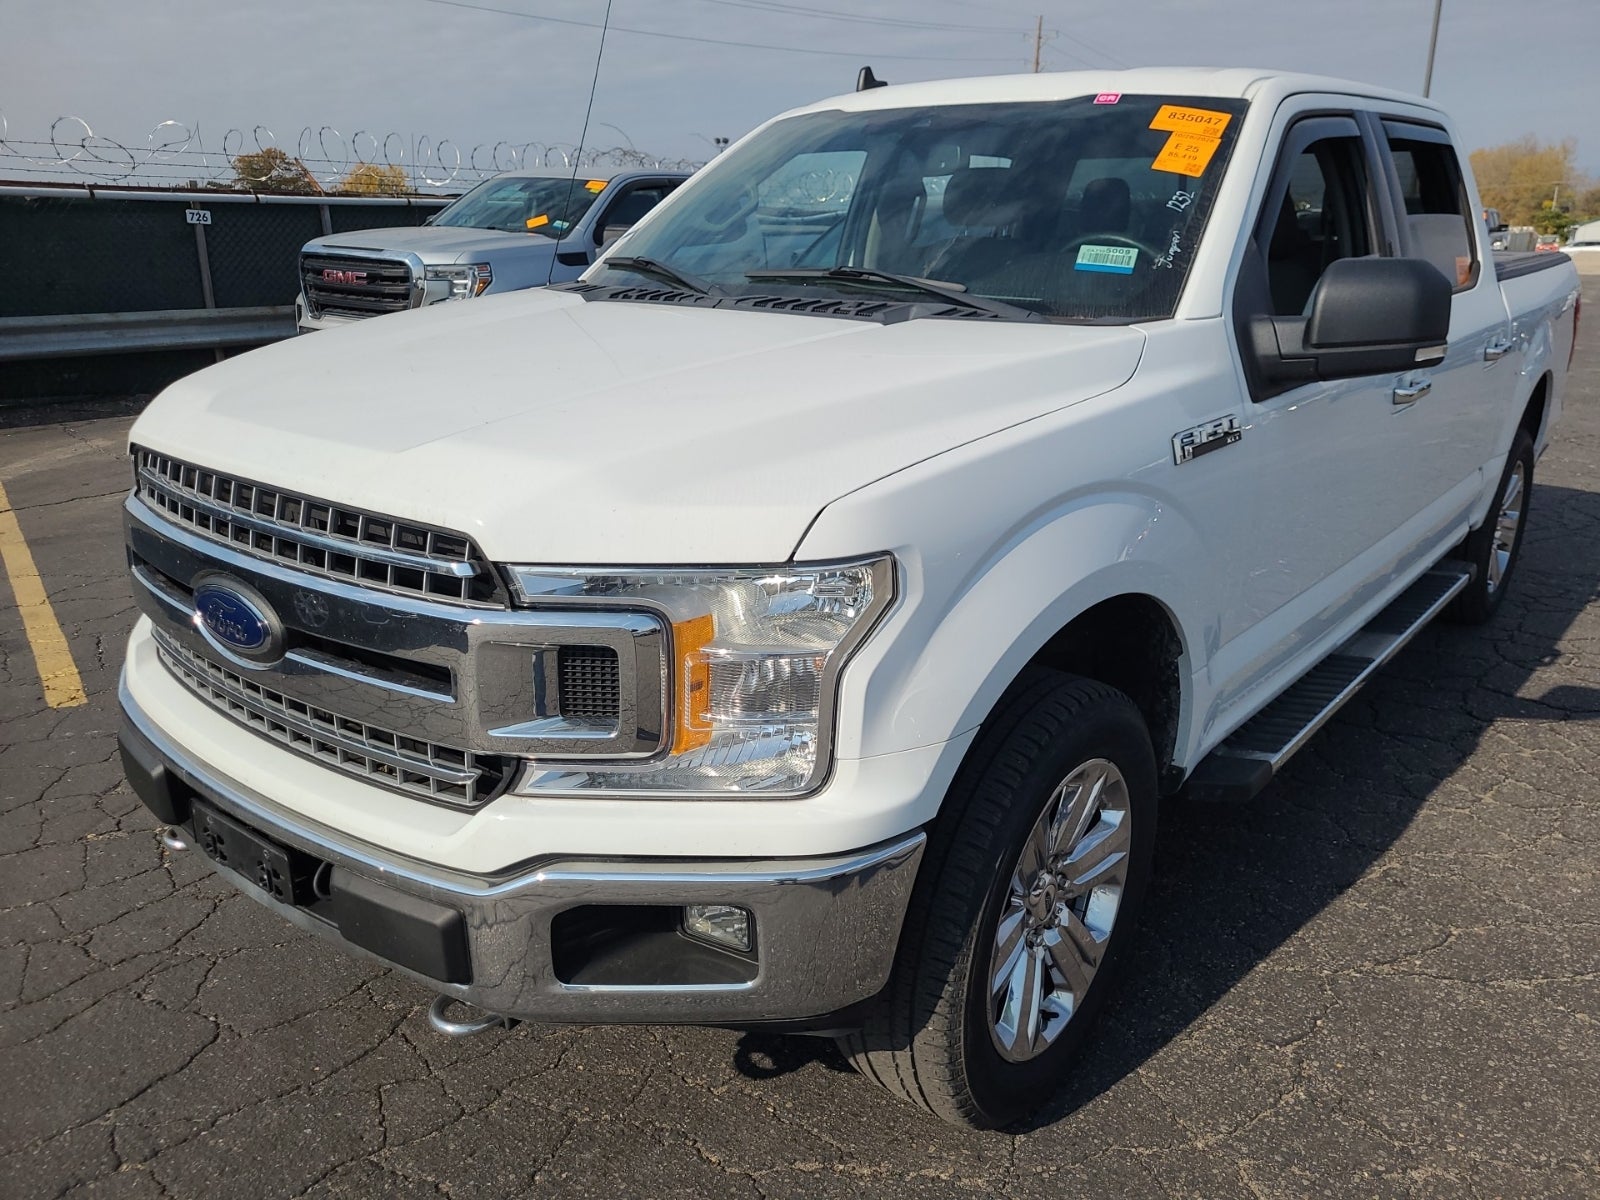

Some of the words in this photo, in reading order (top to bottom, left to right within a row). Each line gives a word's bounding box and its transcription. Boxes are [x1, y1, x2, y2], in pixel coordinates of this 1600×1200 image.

[1168, 112, 1222, 126] 835047
[1185, 145, 1200, 153] 25
[1166, 190, 1195, 212] 1232
[189, 212, 209, 222] 726
[323, 269, 368, 285] GMC
[1227, 432, 1241, 444] XLT
[206, 597, 248, 642] Ford
